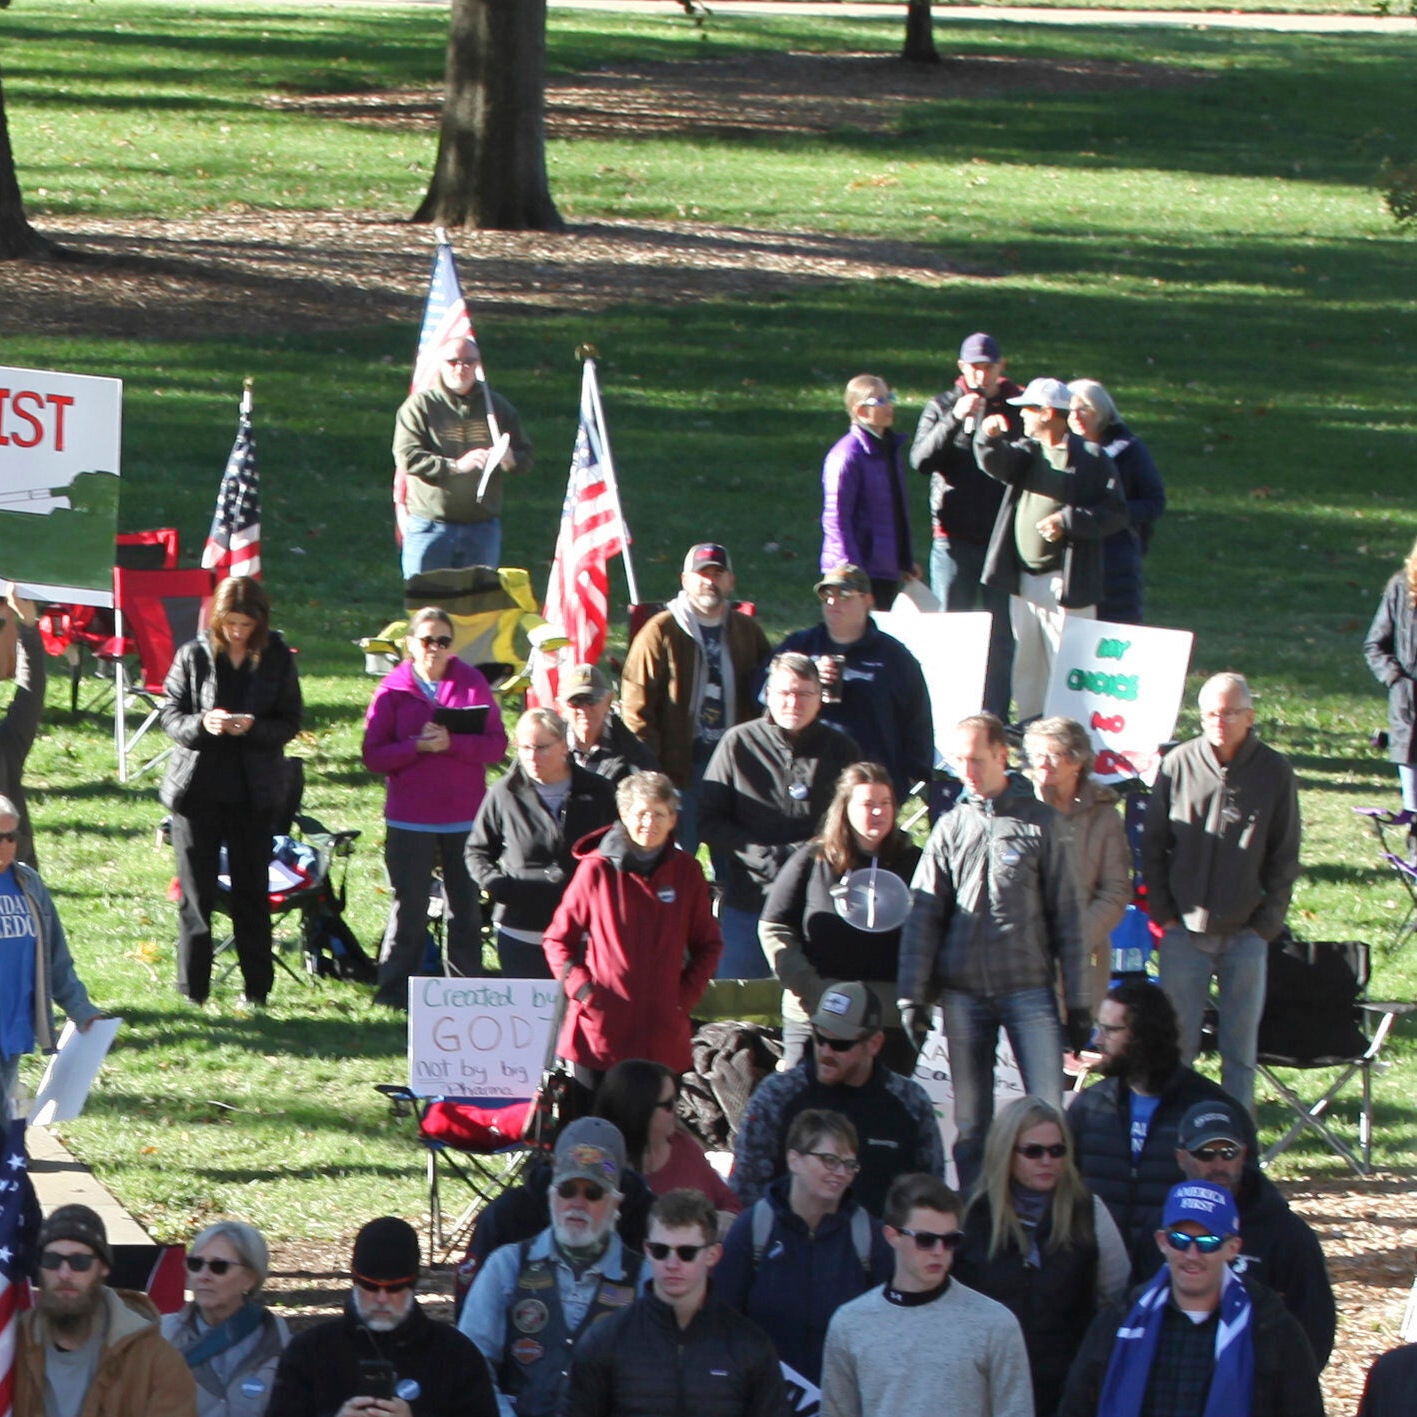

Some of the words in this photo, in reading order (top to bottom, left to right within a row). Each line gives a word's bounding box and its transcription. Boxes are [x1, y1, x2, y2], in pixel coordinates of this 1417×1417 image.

[423, 978, 516, 1008] Created
[432, 1014, 535, 1052] GOD
[417, 1058, 451, 1078] not
[460, 1058, 488, 1085] by
[500, 1060, 529, 1084] big
